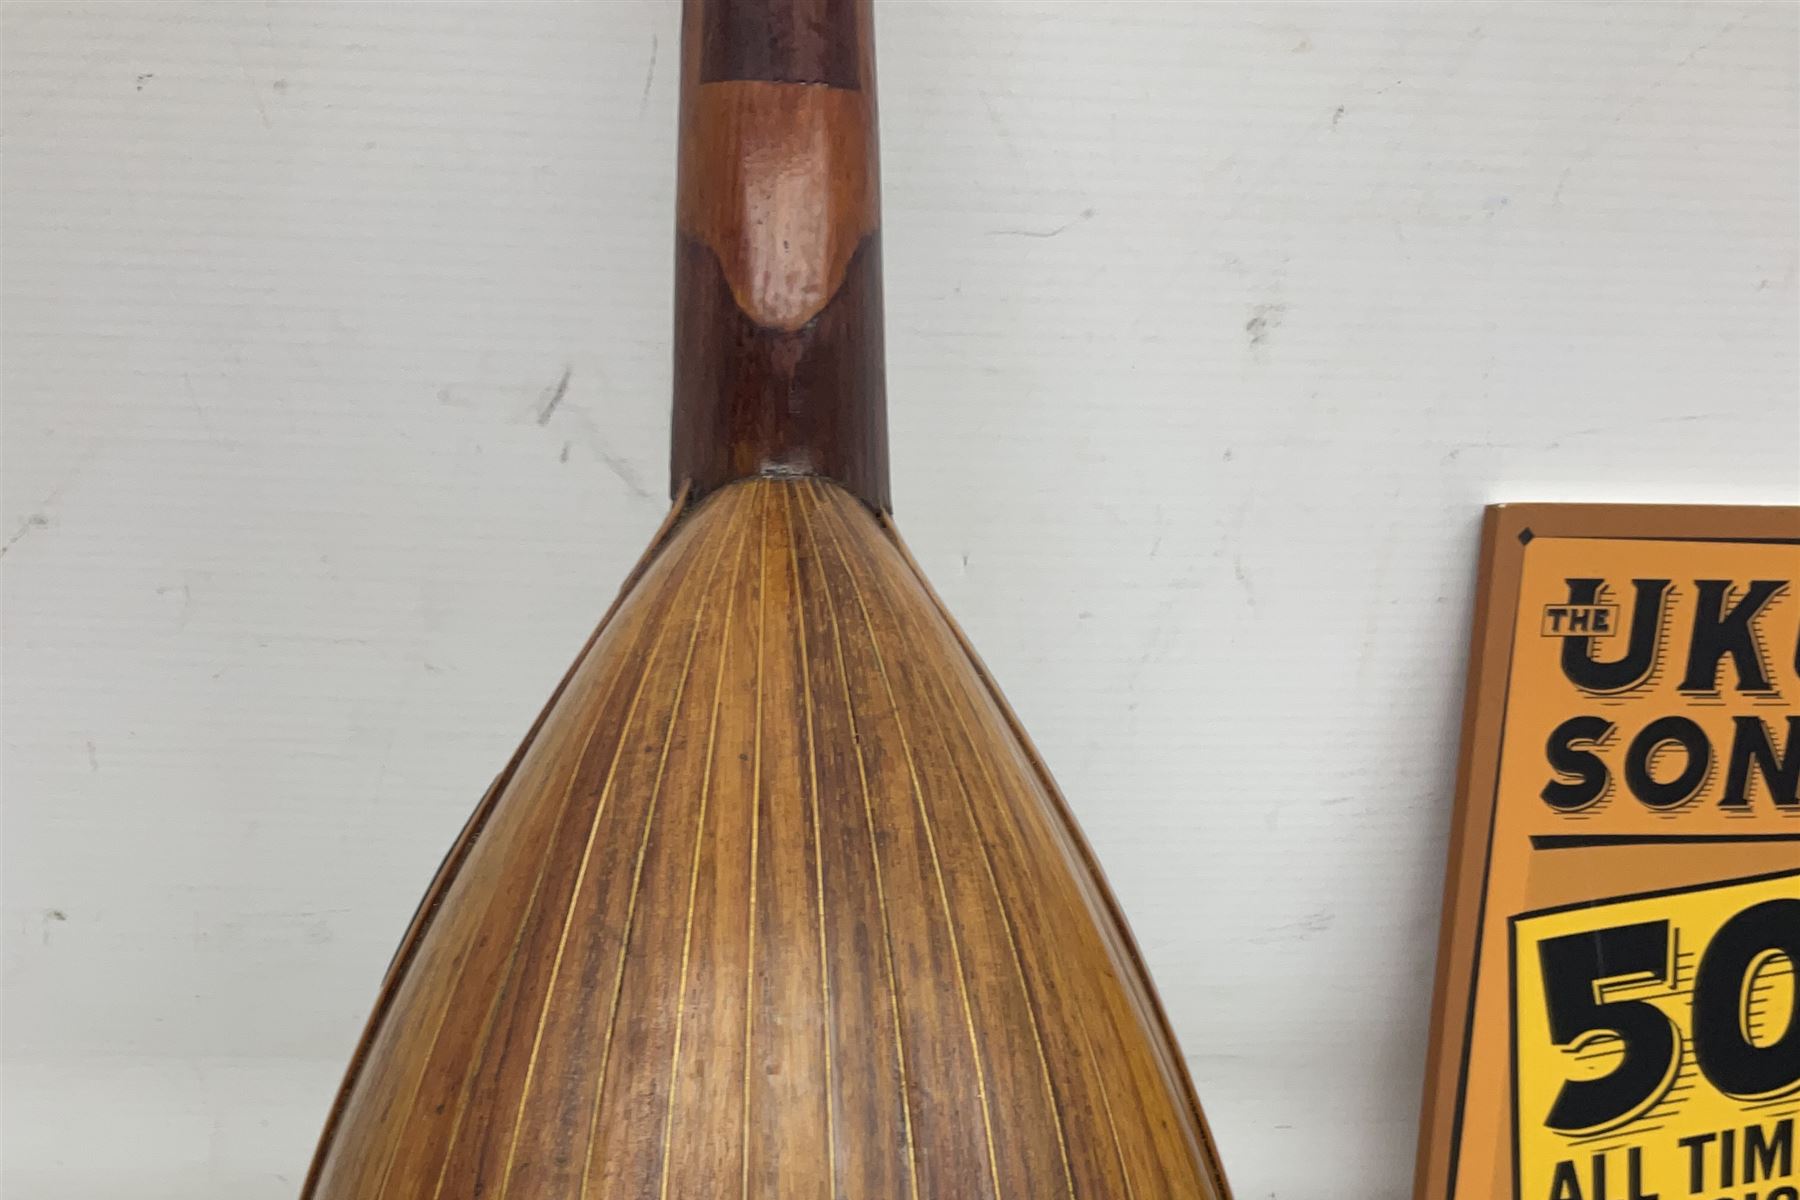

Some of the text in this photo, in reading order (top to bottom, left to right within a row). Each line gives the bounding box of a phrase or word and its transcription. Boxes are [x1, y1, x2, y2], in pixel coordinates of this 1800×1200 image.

[1547, 608, 1610, 632] THE
[1560, 578, 1800, 698] UK
[1540, 715, 1800, 812] SON
[1536, 898, 1800, 1136] 50
[1678, 1118, 1794, 1194] TIM
